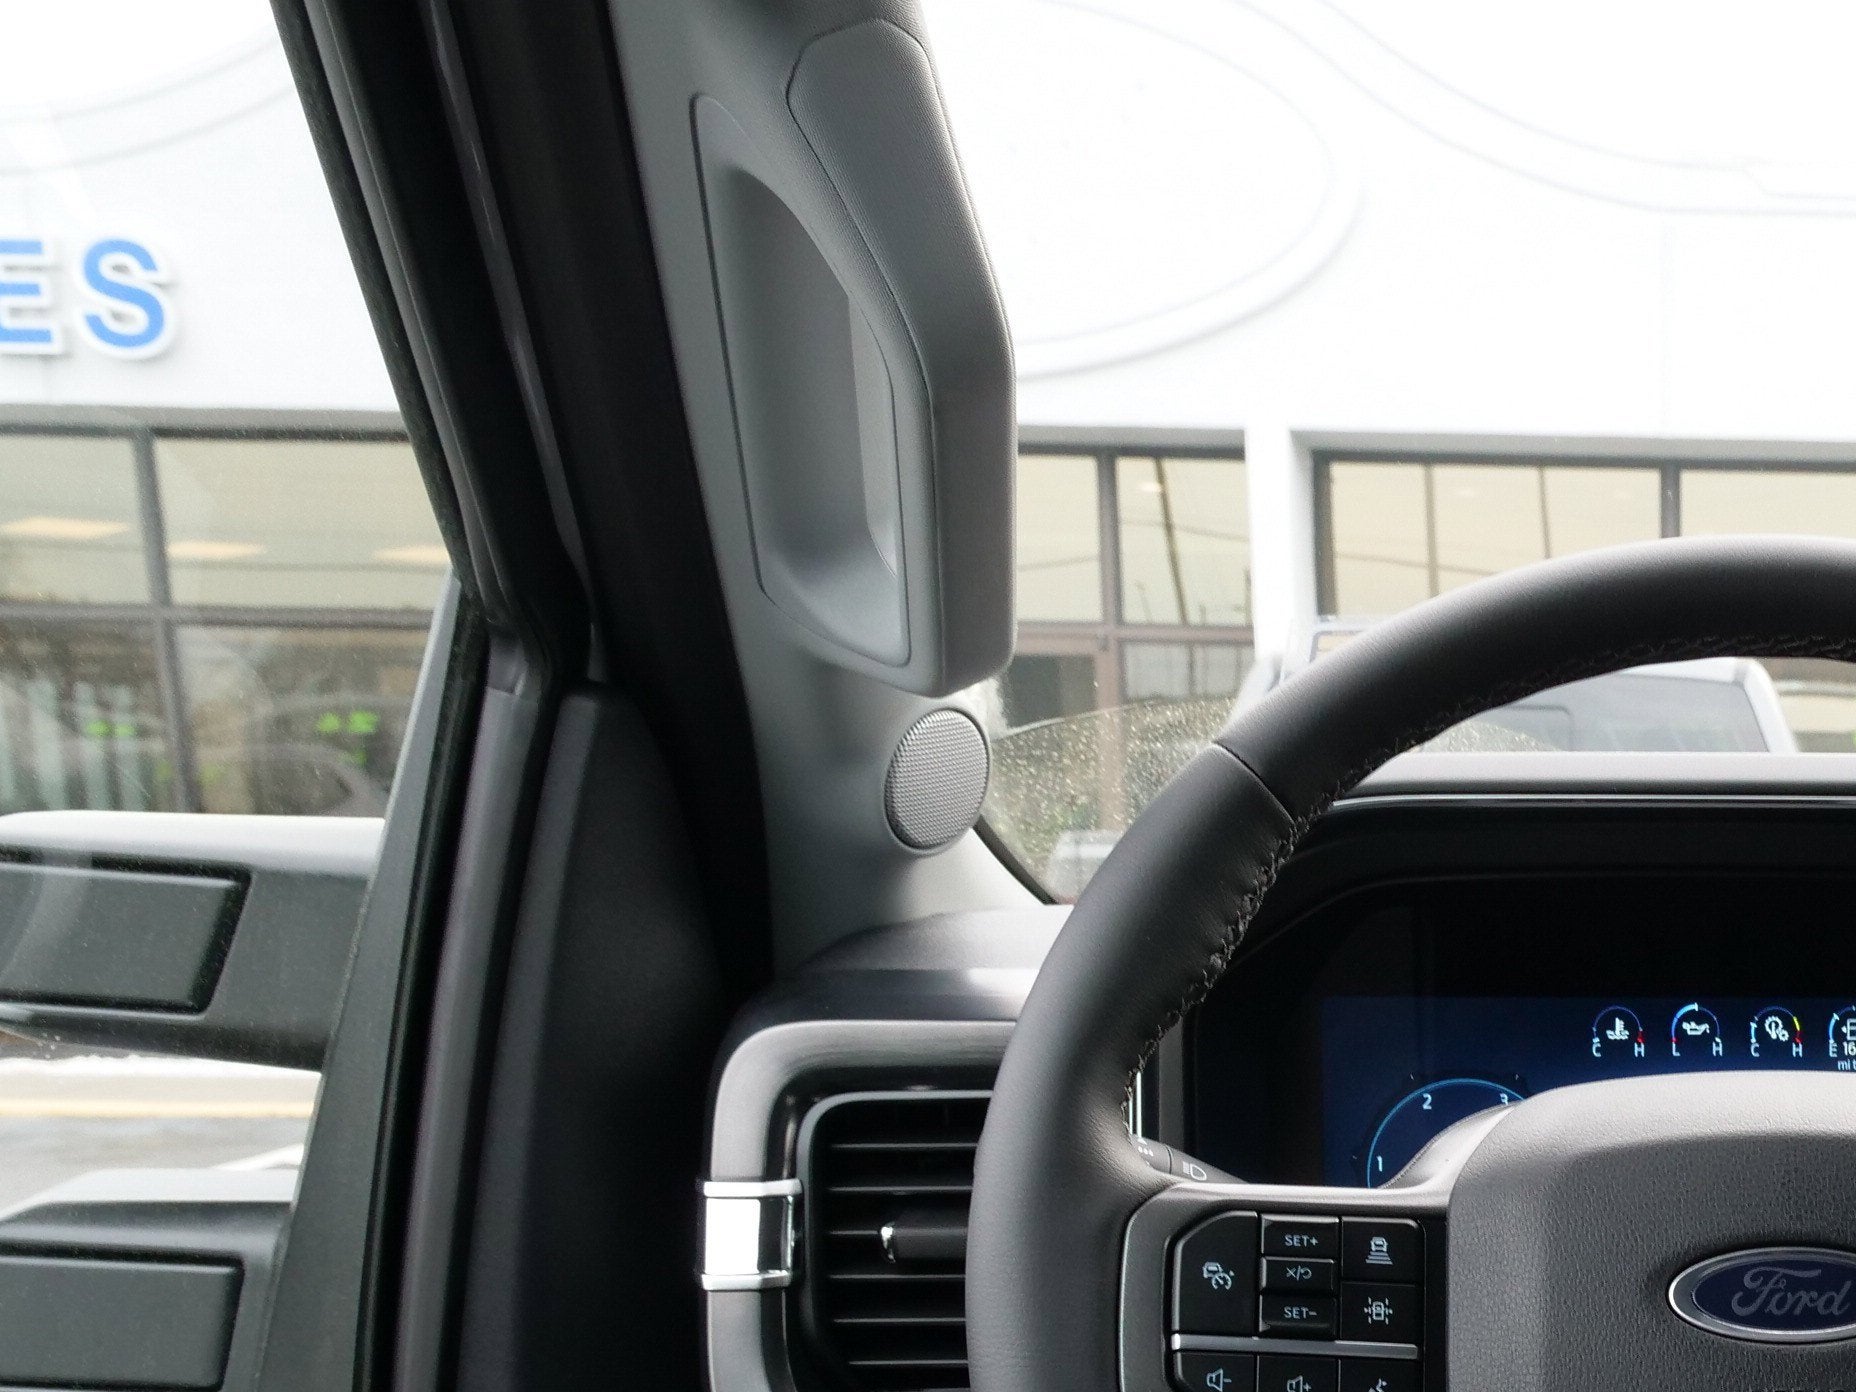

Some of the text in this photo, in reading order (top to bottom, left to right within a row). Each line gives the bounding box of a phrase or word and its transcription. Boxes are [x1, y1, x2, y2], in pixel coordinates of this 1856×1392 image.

[1837, 1060, 1850, 1071] mi
[1422, 1093, 1433, 1110] 2
[1730, 1265, 1852, 1317] Ford
